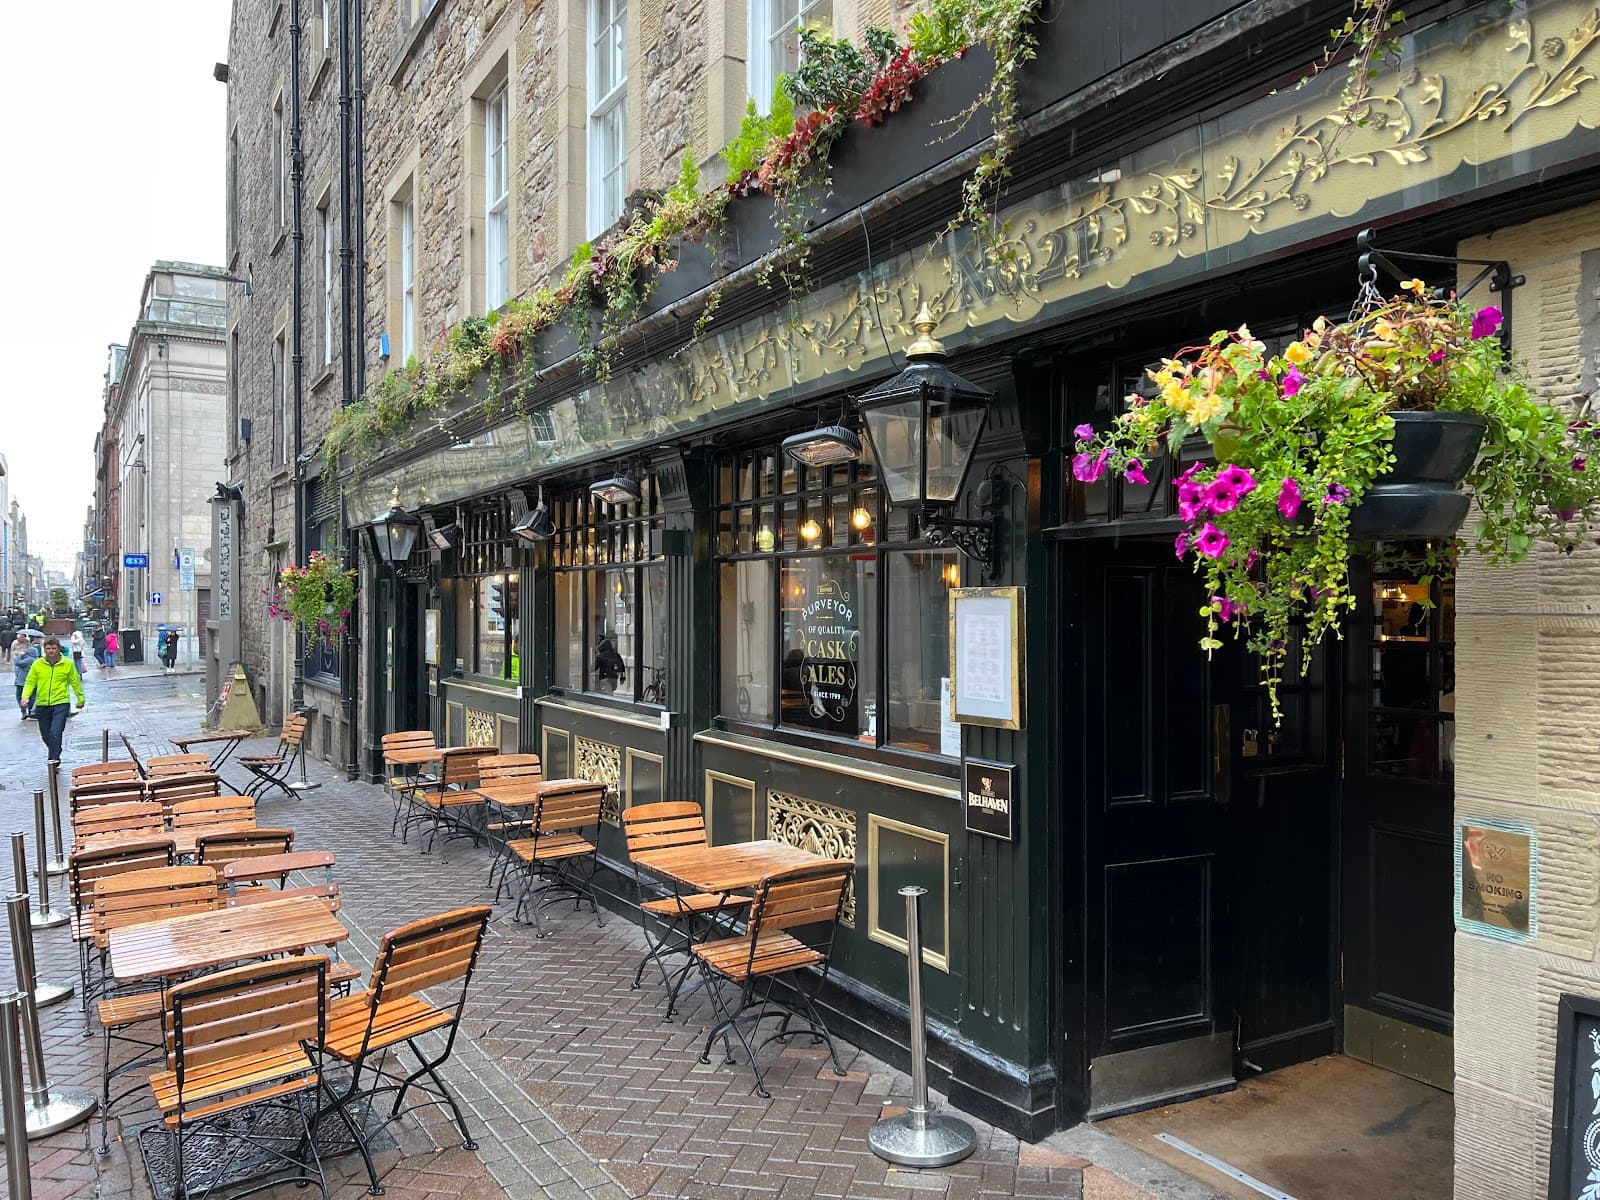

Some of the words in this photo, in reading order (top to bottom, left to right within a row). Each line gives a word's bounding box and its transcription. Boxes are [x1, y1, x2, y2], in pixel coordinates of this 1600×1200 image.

[802, 599, 853, 621] PURVEYOR
[817, 626, 846, 635] QUALITY
[807, 640, 847, 659] CASK
[807, 664, 846, 685] ALES
[968, 791, 1008, 814] BELHAVEN
[1486, 872, 1504, 884] NO
[1468, 880, 1523, 900] SMOKING
